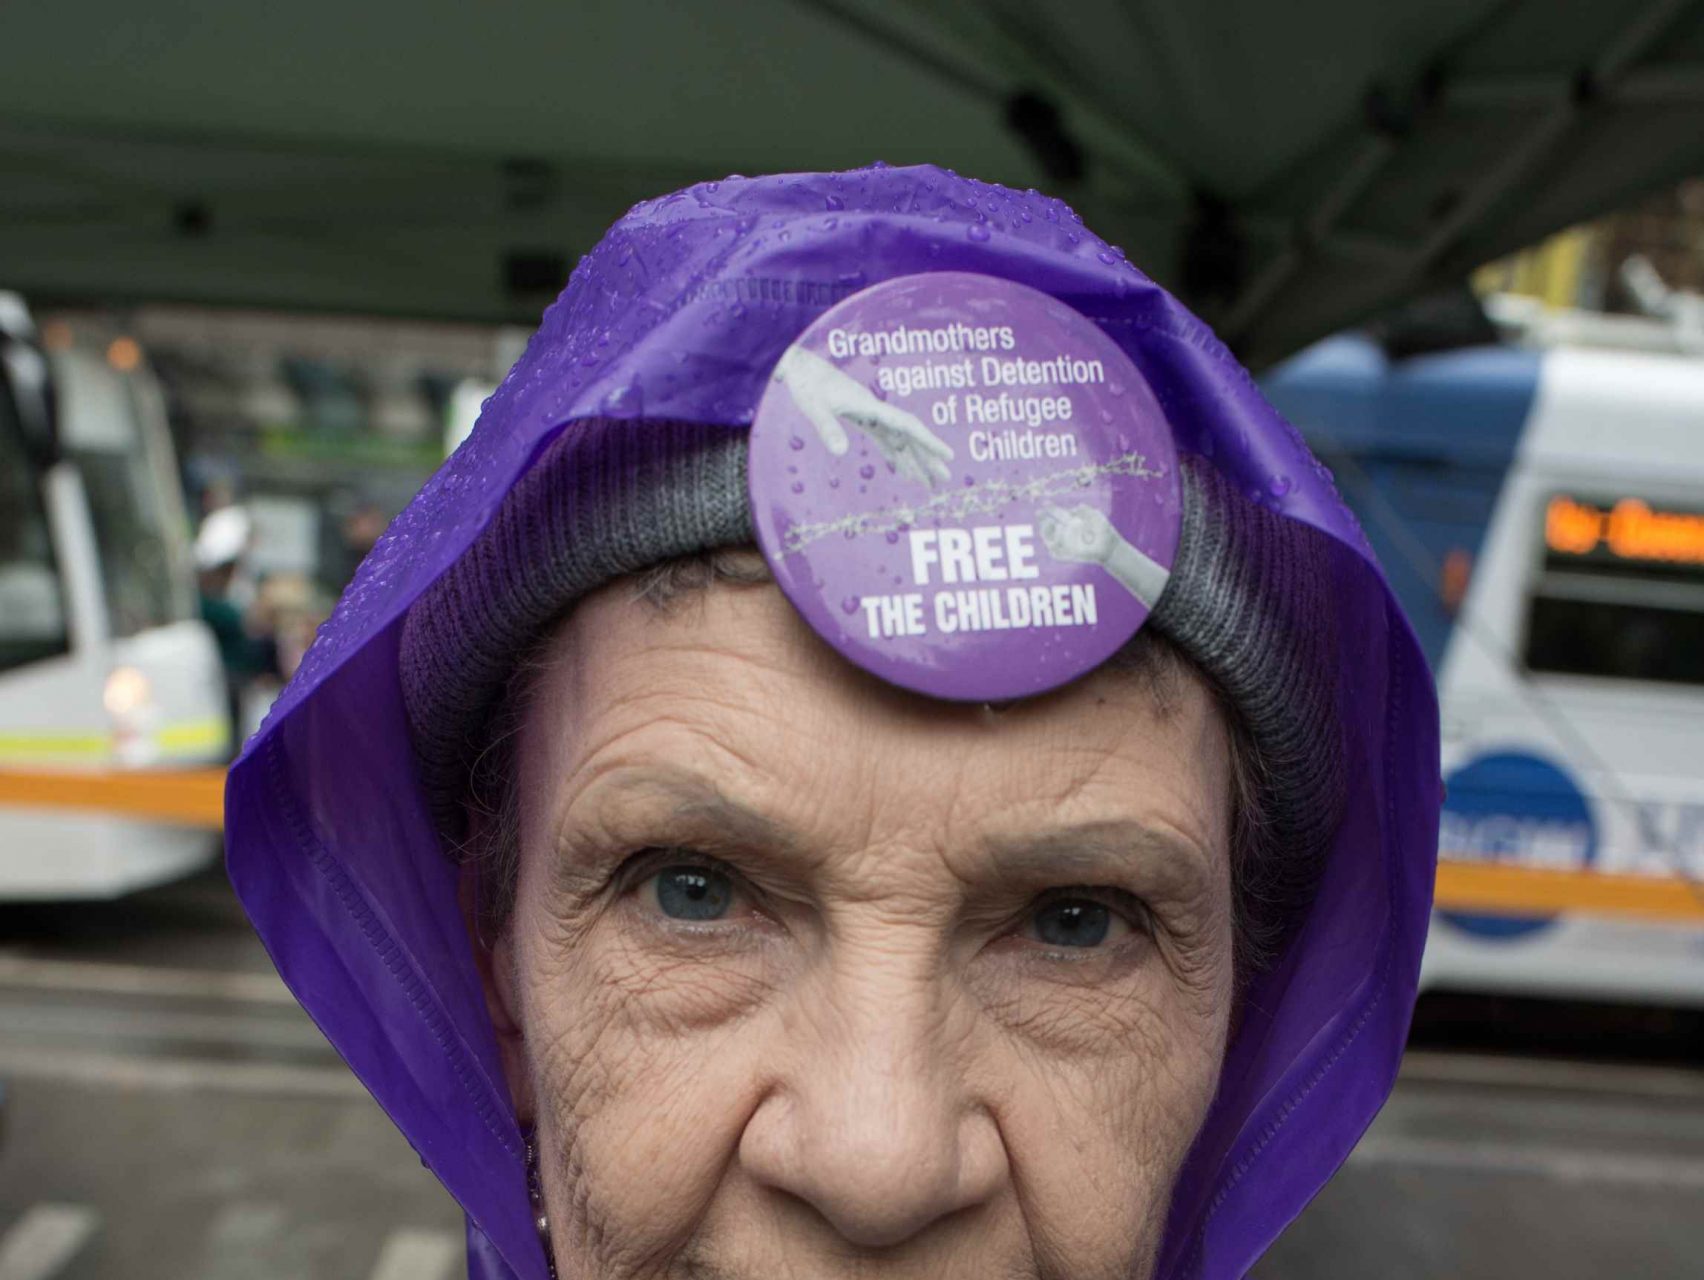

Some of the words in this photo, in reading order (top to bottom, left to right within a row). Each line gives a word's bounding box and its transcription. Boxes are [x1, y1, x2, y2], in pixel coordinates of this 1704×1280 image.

[828, 323, 1015, 357] Grandmothers
[878, 359, 976, 395] against
[982, 355, 1104, 386] Detention
[932, 395, 957, 425] of
[966, 393, 1072, 427] Refugee
[969, 431, 1076, 462] Children
[909, 525, 1039, 585] FREE
[861, 594, 926, 638] THE
[934, 584, 1098, 633] CHILDREN
